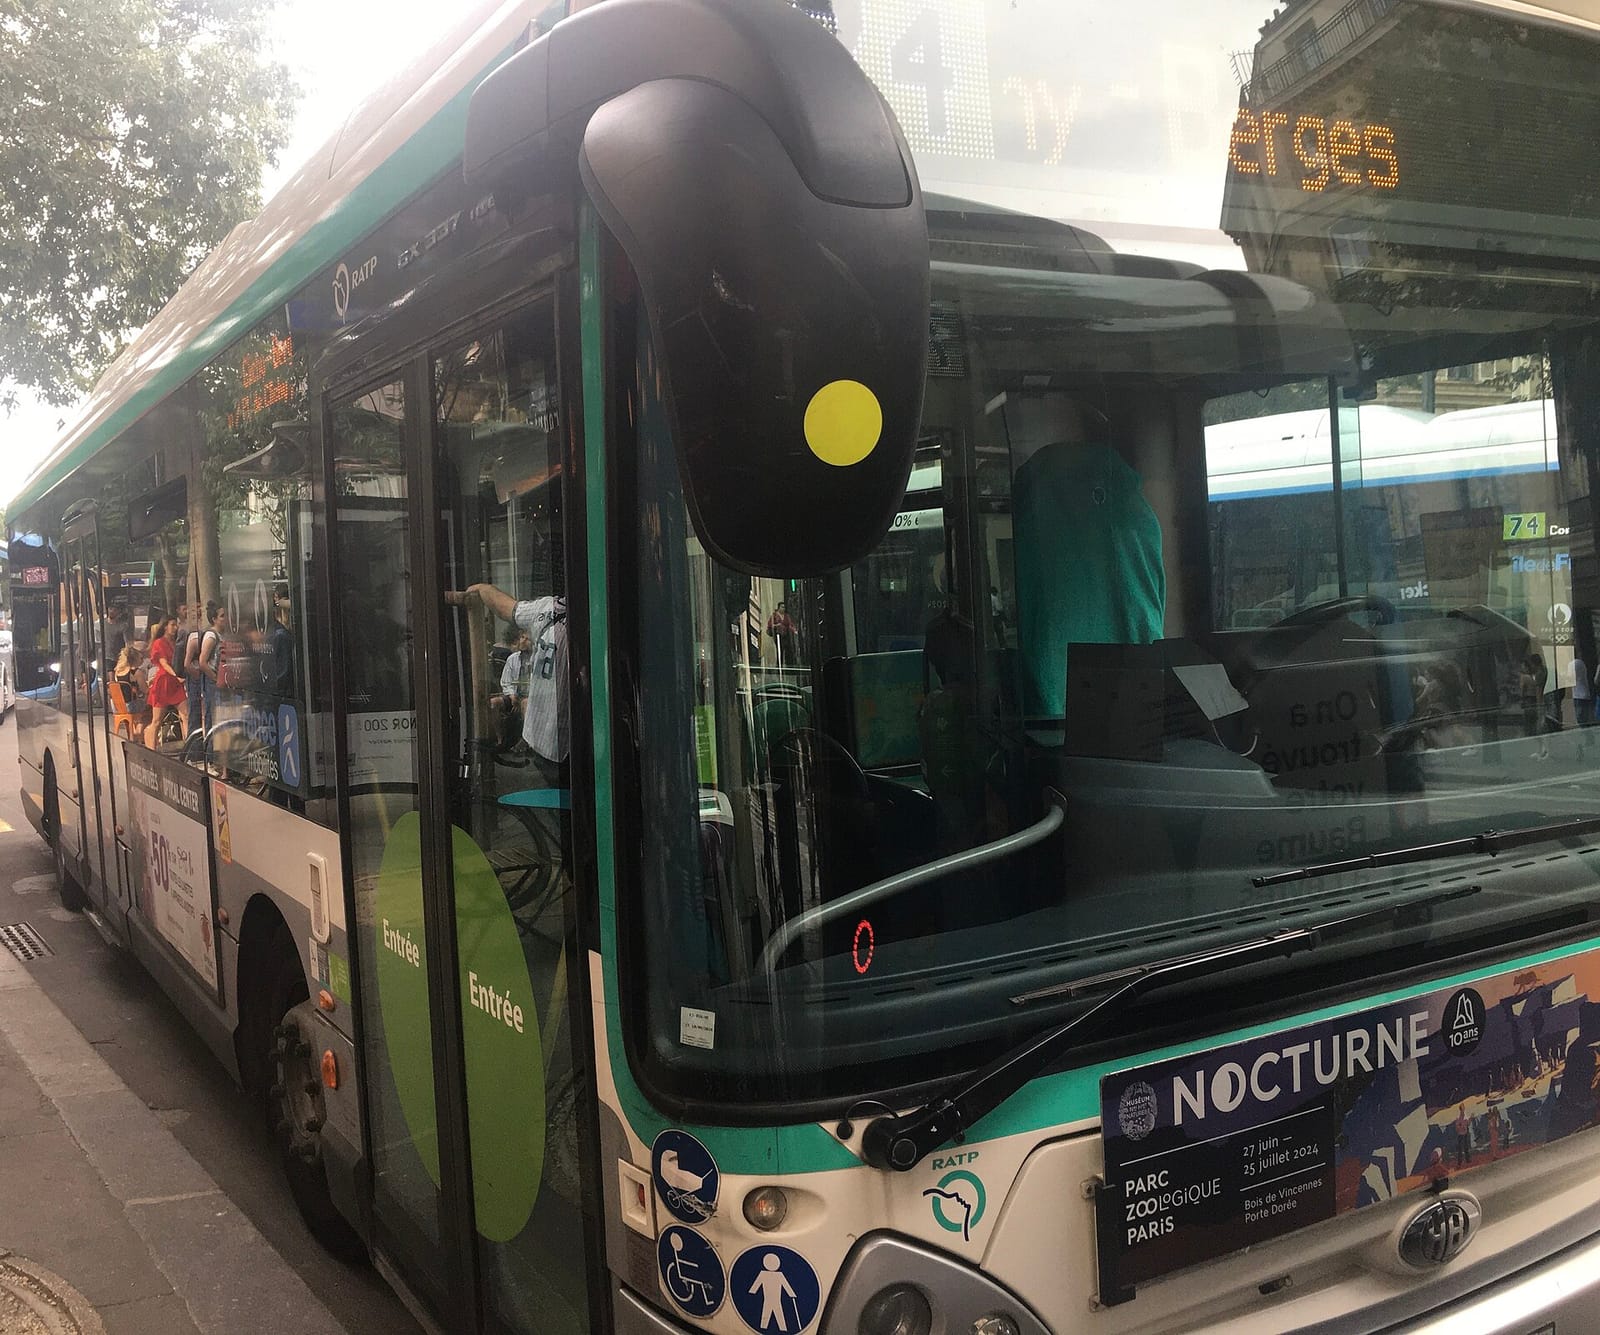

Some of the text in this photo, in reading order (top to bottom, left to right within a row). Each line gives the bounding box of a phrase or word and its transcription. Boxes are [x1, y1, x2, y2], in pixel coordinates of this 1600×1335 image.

[351, 255, 378, 290] RATP
[1510, 515, 1539, 537] 74
[179, 785, 200, 814] CENTER
[382, 918, 421, 969] Entrée
[468, 970, 525, 1035] Entrée
[1449, 1027, 1479, 1048] 10 ans
[1172, 1010, 1431, 1127] NOCTURNE
[932, 1151, 980, 1170] RATP
[1242, 1145, 1255, 1158] 27
[1257, 1135, 1279, 1153] juin
[1243, 1143, 1319, 1176] 25 juillet 2024
[1125, 1170, 1169, 1198] PARC
[1244, 1177, 1322, 1211] Bois de Vincennes
[1244, 1199, 1297, 1225] Porte Dorée
